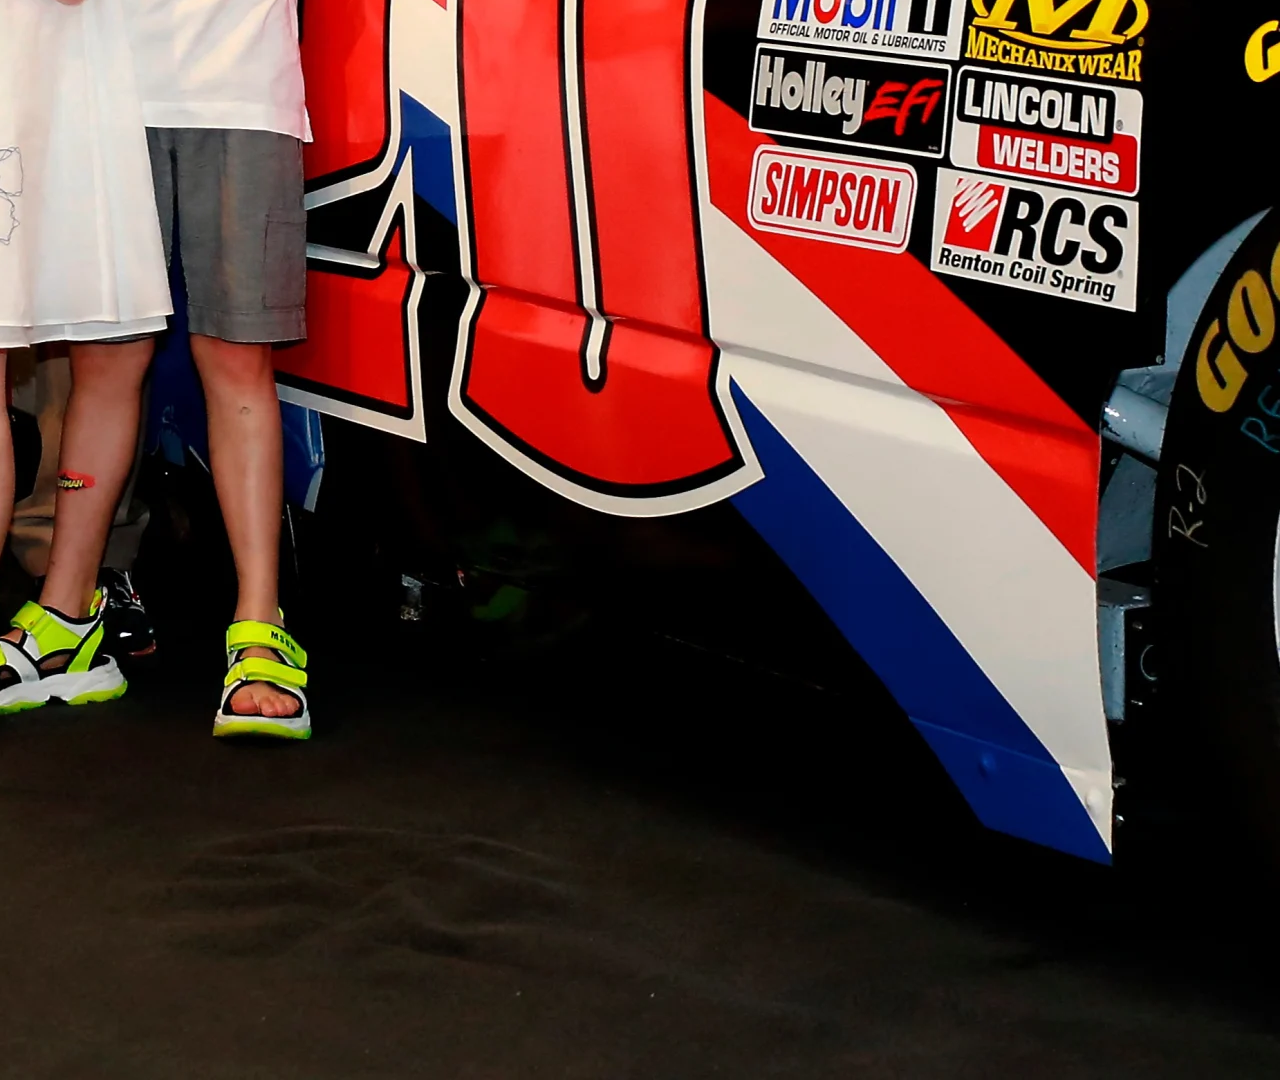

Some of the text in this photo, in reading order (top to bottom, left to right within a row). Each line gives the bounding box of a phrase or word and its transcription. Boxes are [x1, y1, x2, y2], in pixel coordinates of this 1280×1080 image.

[769, 21, 946, 52] OFFICIAL MOTOR OIL & LUBRICANTS
[967, 25, 1144, 82] MECHANIX WEAR
[755, 54, 868, 136] Holley
[964, 77, 1109, 137] LINCOLN
[992, 132, 1121, 184] WELDERS
[761, 161, 903, 234] SIMPSON
[995, 186, 1129, 275] RCS
[938, 247, 1116, 303] Renton Coil Spring
